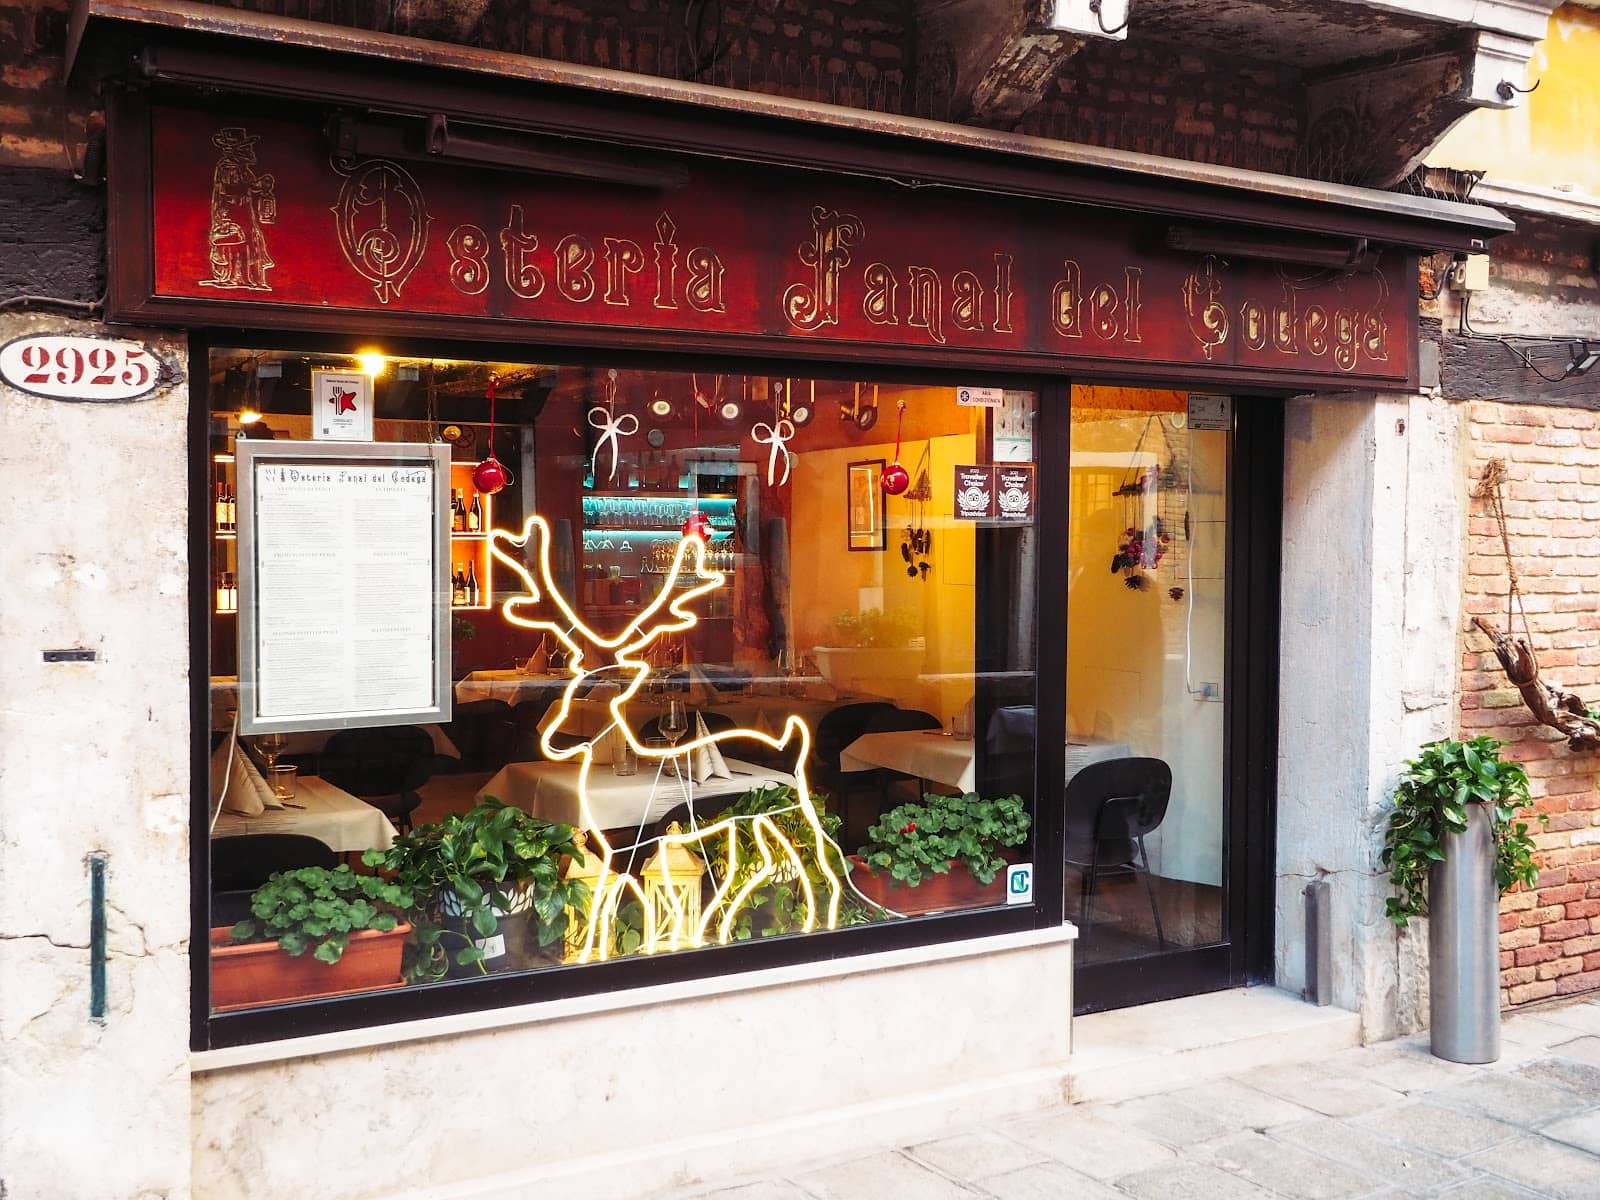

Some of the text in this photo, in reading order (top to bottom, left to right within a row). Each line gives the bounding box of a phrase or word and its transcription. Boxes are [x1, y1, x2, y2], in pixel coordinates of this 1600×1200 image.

[329, 152, 725, 312] Osteria
[783, 204, 1013, 344] Fanal
[1052, 259, 1142, 343] del
[21, 346, 149, 386] 2925
